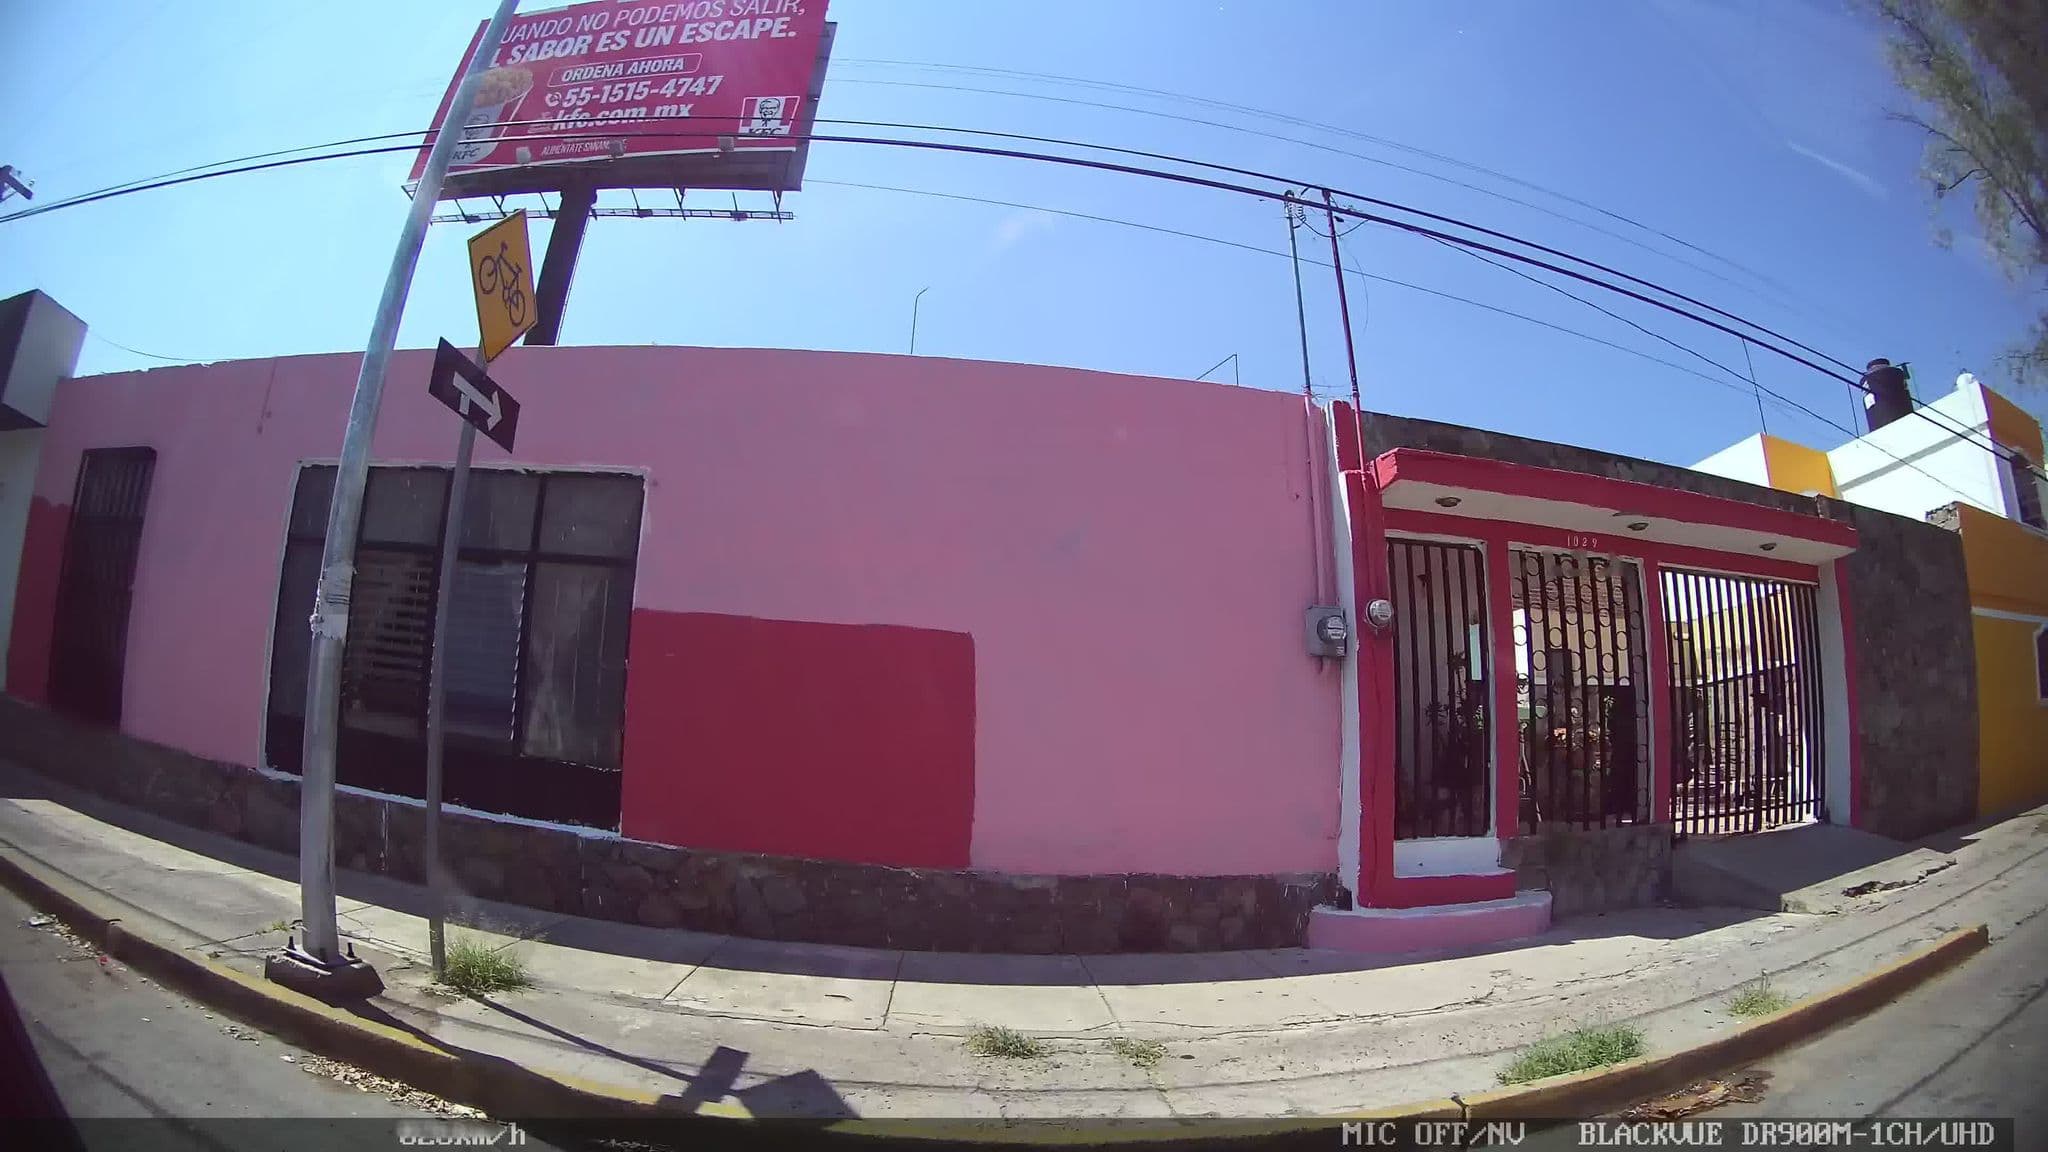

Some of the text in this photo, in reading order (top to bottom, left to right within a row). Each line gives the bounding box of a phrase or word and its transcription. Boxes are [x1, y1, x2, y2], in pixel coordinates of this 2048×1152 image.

[500, 0, 806, 44] UANDO NO PODEMOS SALIR,
[507, 34, 594, 65] SABOR
[596, 30, 632, 53] ES
[634, 25, 676, 48] UN
[678, 17, 798, 45] ESCAPE.
[561, 58, 685, 82] ORDENA AHORA
[563, 75, 724, 108] 55-1515-4747
[551, 103, 695, 131] kfc.com.mx
[1567, 533, 1598, 548] 1029
